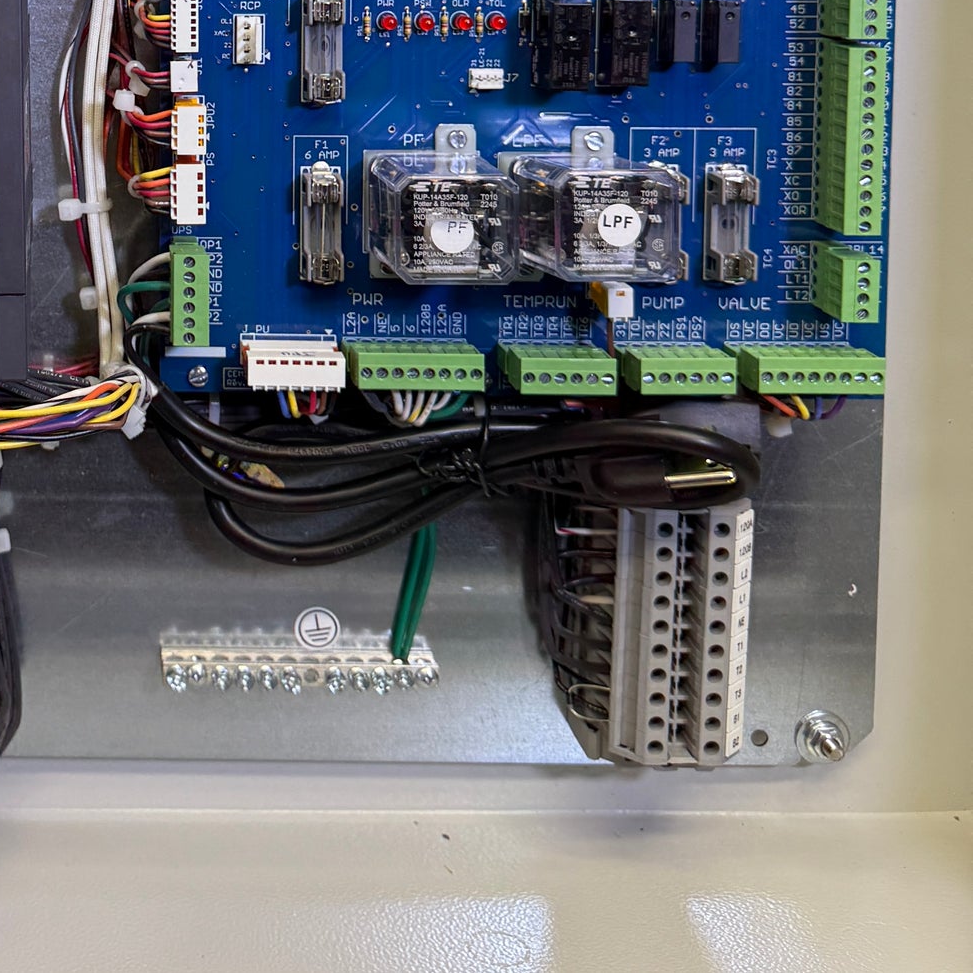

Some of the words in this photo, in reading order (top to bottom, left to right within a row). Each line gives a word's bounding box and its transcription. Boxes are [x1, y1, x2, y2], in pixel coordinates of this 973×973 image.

[240, 1, 261, 10] RCP
[206, 102, 215, 129] JPU2
[315, 140, 328, 149] F1
[717, 136, 732, 145] F3
[305, 151, 311, 159] 6
[318, 151, 340, 159] AMP
[709, 148, 717, 157] 3
[723, 148, 745, 157] AMP
[447, 221, 466, 233] PF
[603, 215, 634, 229] LPF
[785, 274, 808, 284] LT1
[352, 293, 383, 305] PWR
[785, 290, 808, 300] LT2
[503, 295, 577, 308] TEMPRUN
[642, 297, 684, 309] PUMP
[718, 297, 771, 310] VALVE
[453, 312, 462, 334] GND
